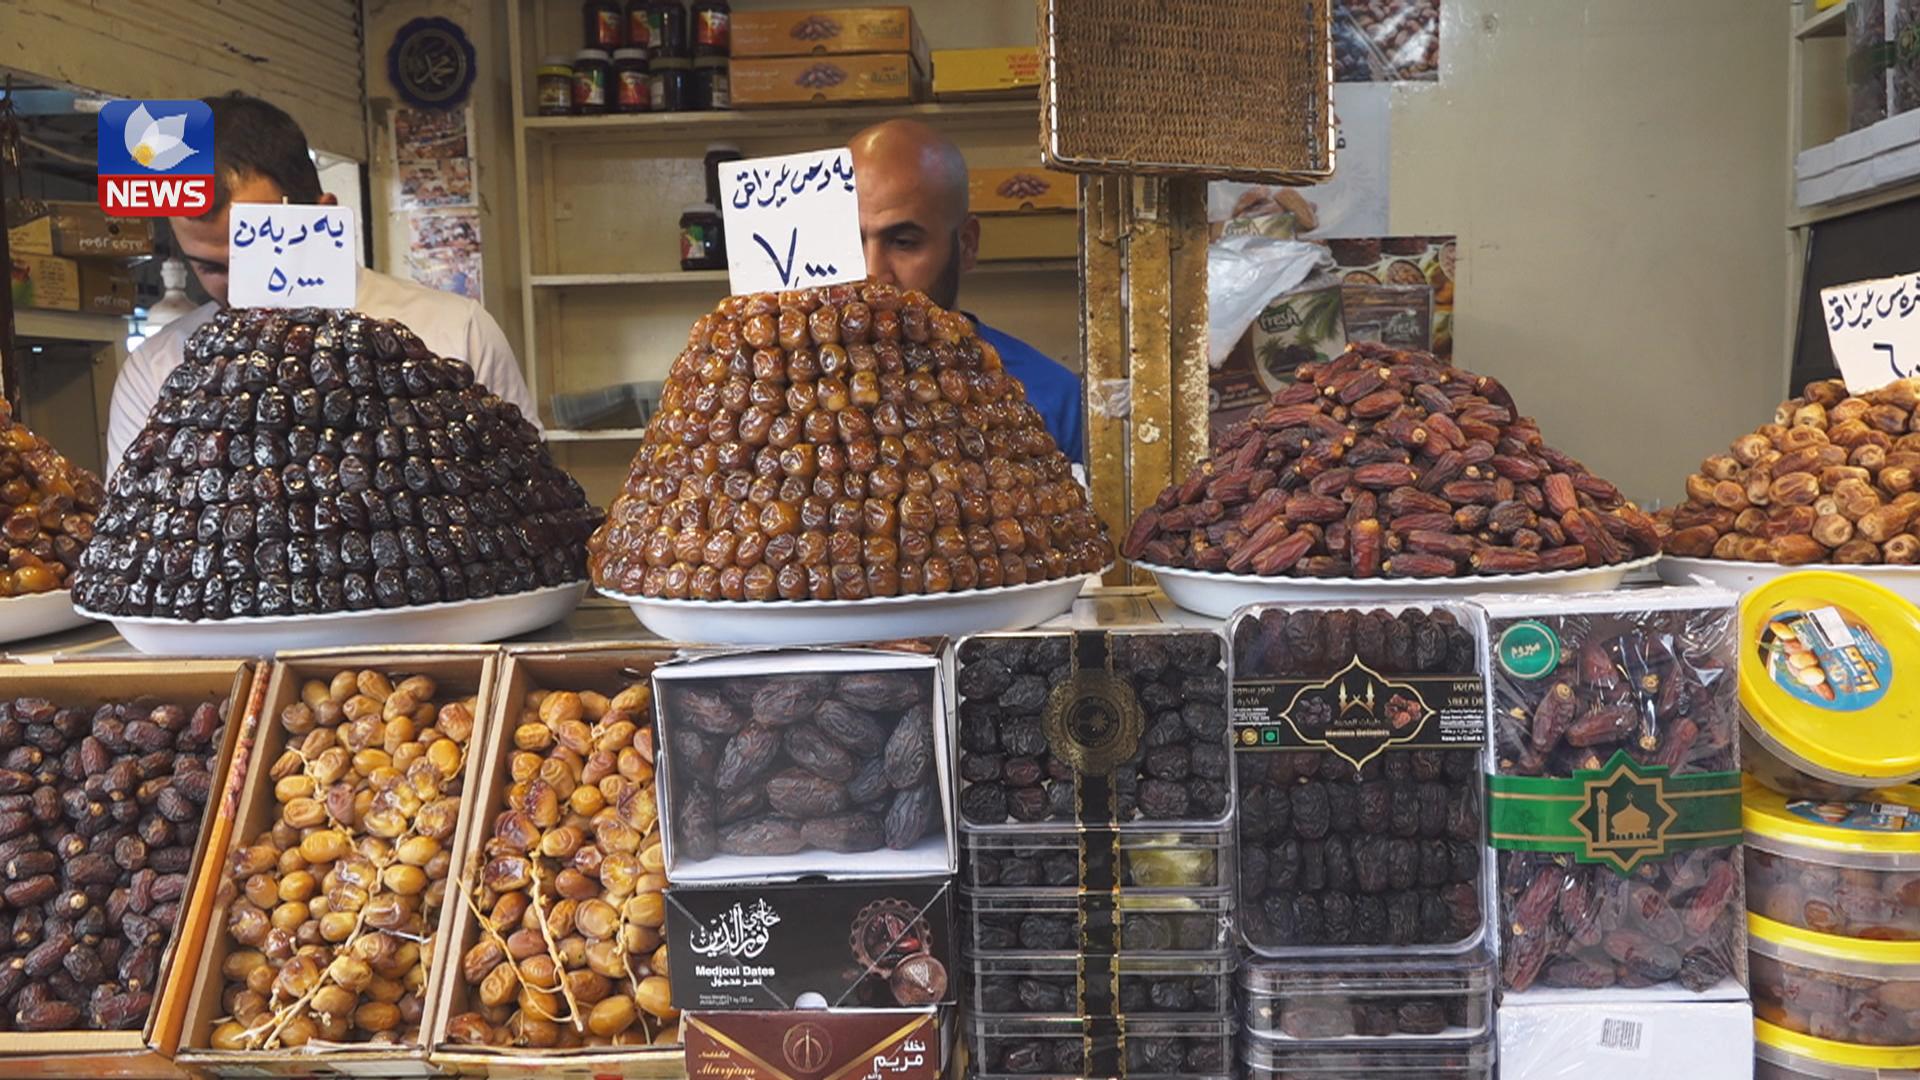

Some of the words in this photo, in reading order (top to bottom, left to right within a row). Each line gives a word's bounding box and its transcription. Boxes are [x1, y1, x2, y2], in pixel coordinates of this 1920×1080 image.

[695, 966, 740, 978] Medjoul
[742, 966, 775, 977] Dates
[873, 1054, 924, 1074] مريم
